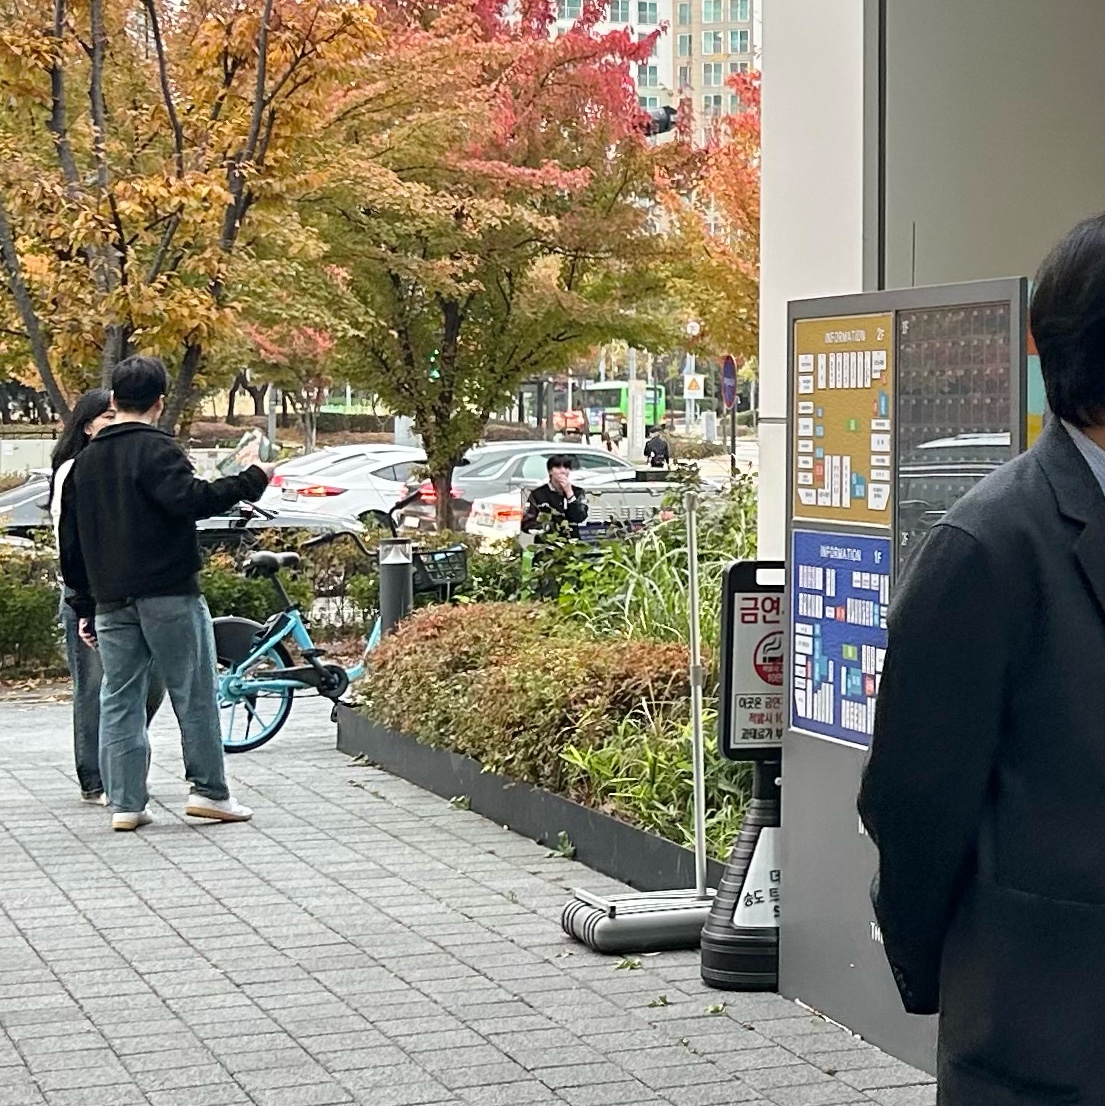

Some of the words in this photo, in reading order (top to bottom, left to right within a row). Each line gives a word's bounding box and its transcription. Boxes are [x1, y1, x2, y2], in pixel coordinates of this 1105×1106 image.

[825, 329, 866, 344] INFORMATION
[820, 545, 862, 562] INFORMATION
[740, 596, 781, 624] 금연
[739, 696, 762, 710] 이곳은
[765, 696, 783, 709] 금연
[744, 889, 765, 907] 송도
